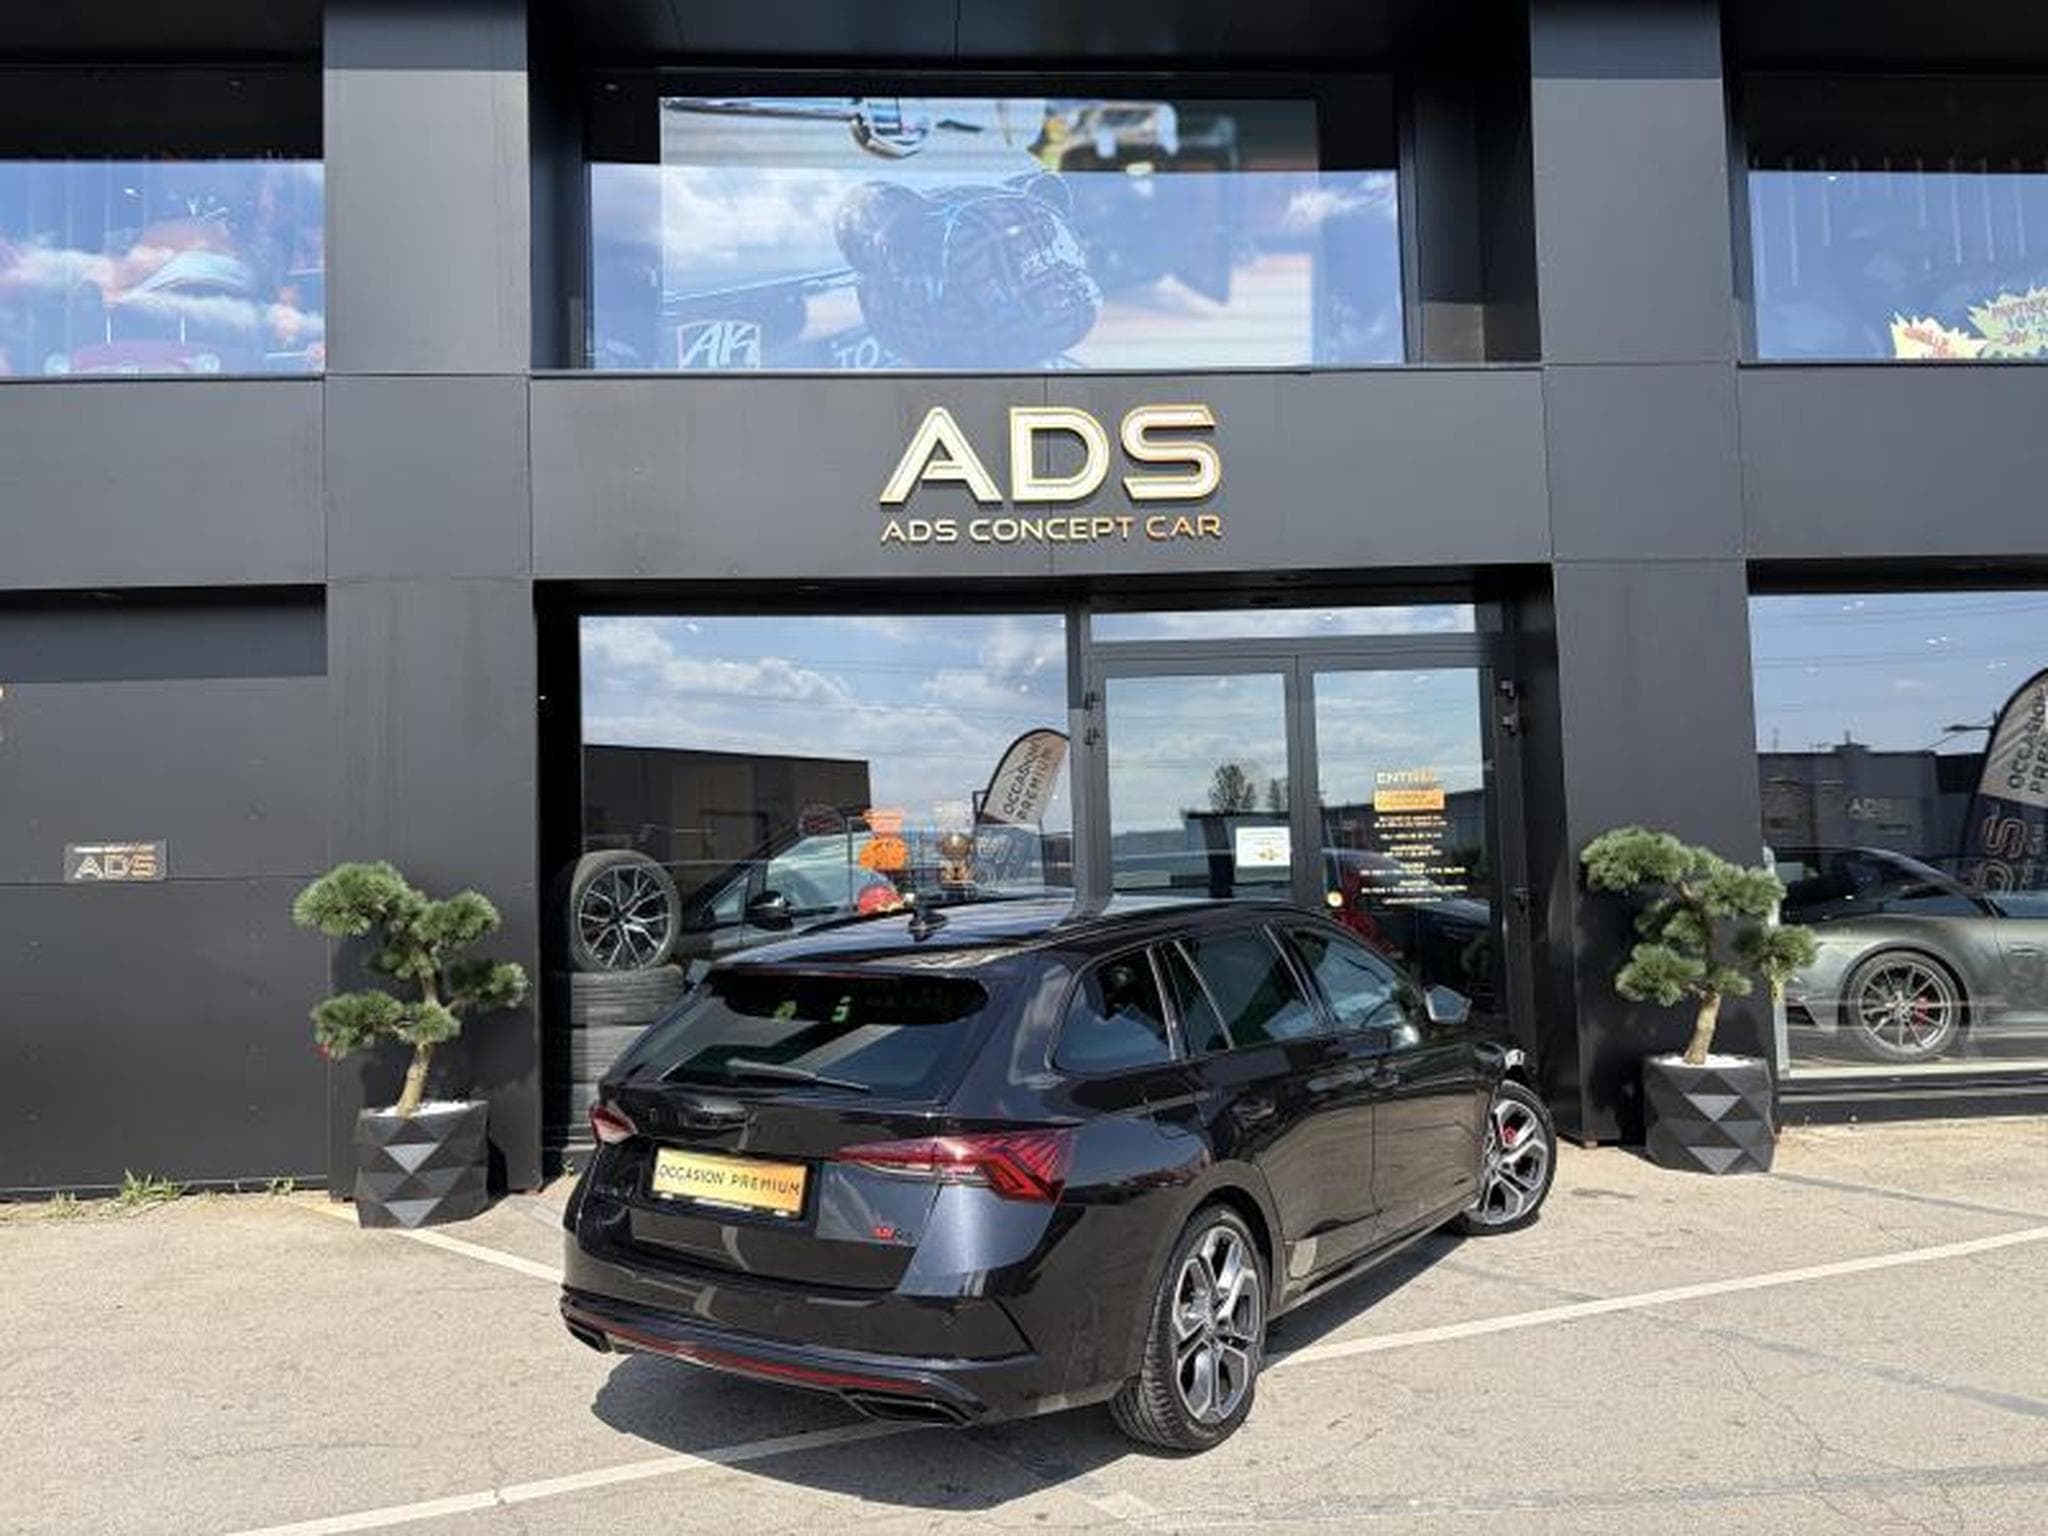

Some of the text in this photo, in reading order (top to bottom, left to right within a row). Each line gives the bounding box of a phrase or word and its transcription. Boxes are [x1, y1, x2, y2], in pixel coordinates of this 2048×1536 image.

[879, 404, 1222, 504] ADS
[880, 515, 1223, 543] ADS CONCEPT CAR
[74, 854, 157, 879] ADS
[658, 1164, 801, 1196] OCCASION PREMIUM
